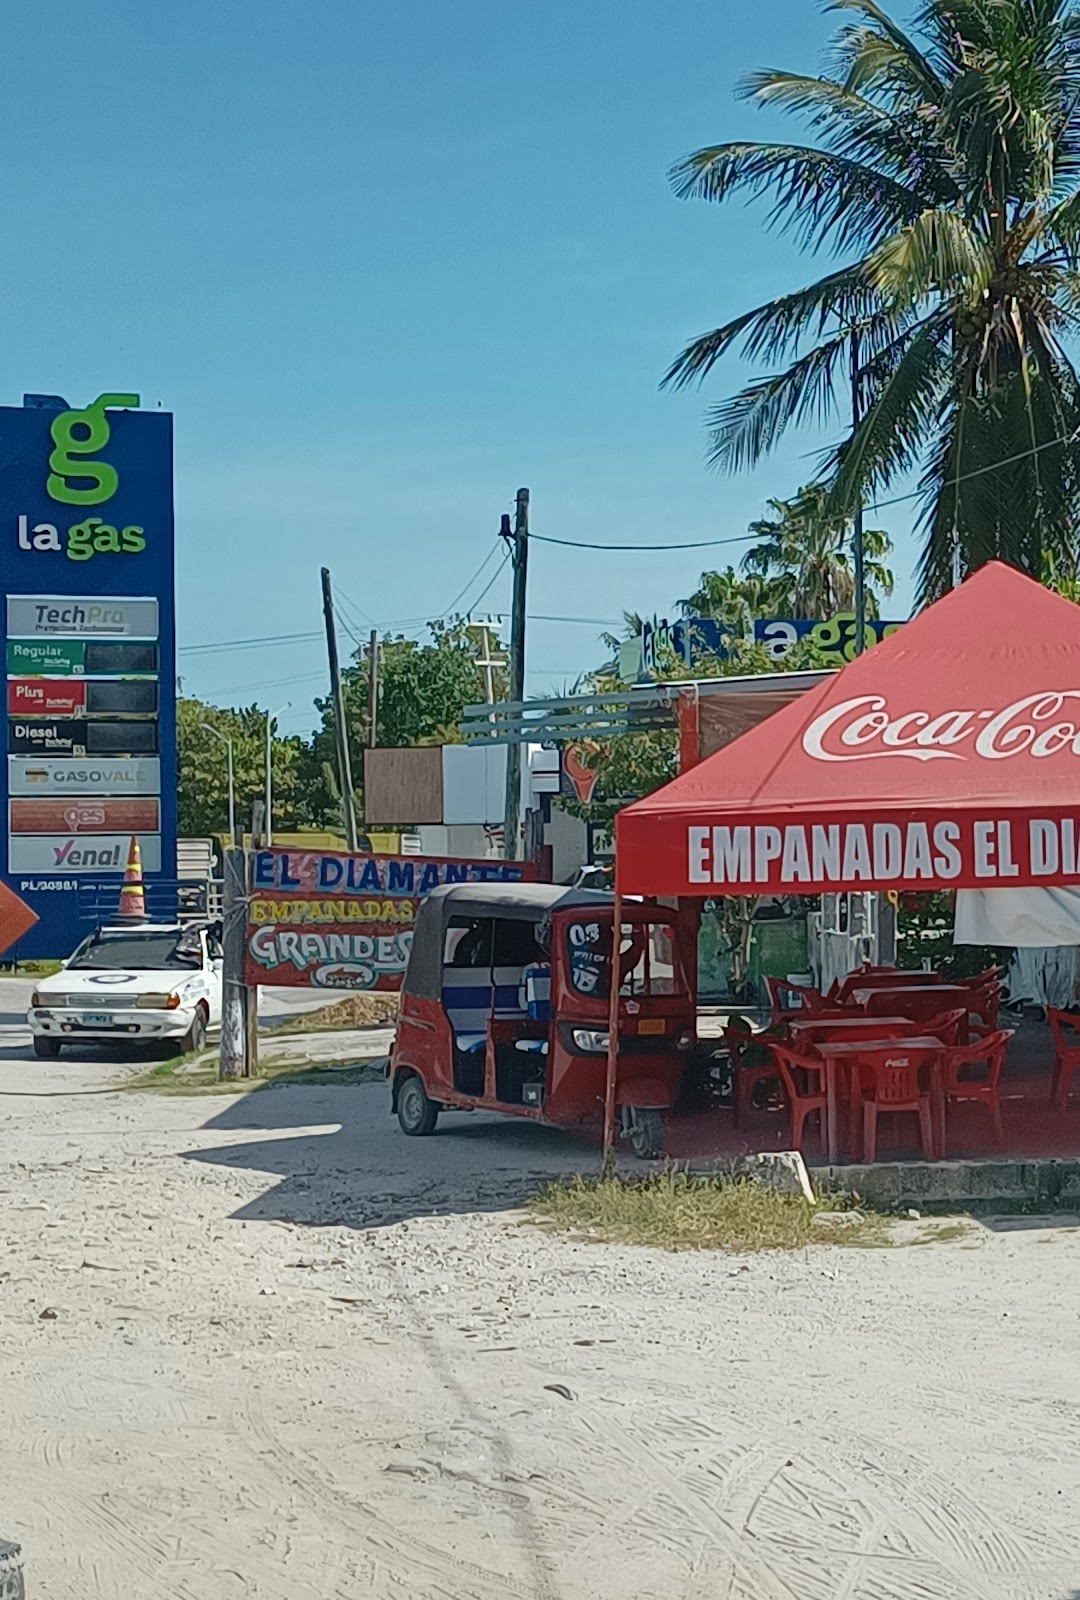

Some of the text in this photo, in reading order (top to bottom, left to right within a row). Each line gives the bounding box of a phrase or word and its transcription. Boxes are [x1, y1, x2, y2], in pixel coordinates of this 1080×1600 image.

[35, 605, 125, 625] TechPro
[13, 644, 63, 657] Regular
[764, 621, 798, 661] a
[16, 686, 44, 697] Plus
[53, 771, 146, 782] GASOVALE
[53, 839, 122, 866] Yena!
[688, 820, 962, 884] EMPANADAS
[973, 820, 1019, 878] EL
[255, 851, 300, 884] EL
[251, 900, 413, 924] EMPANADAS
[251, 925, 414, 967] GRANDES
